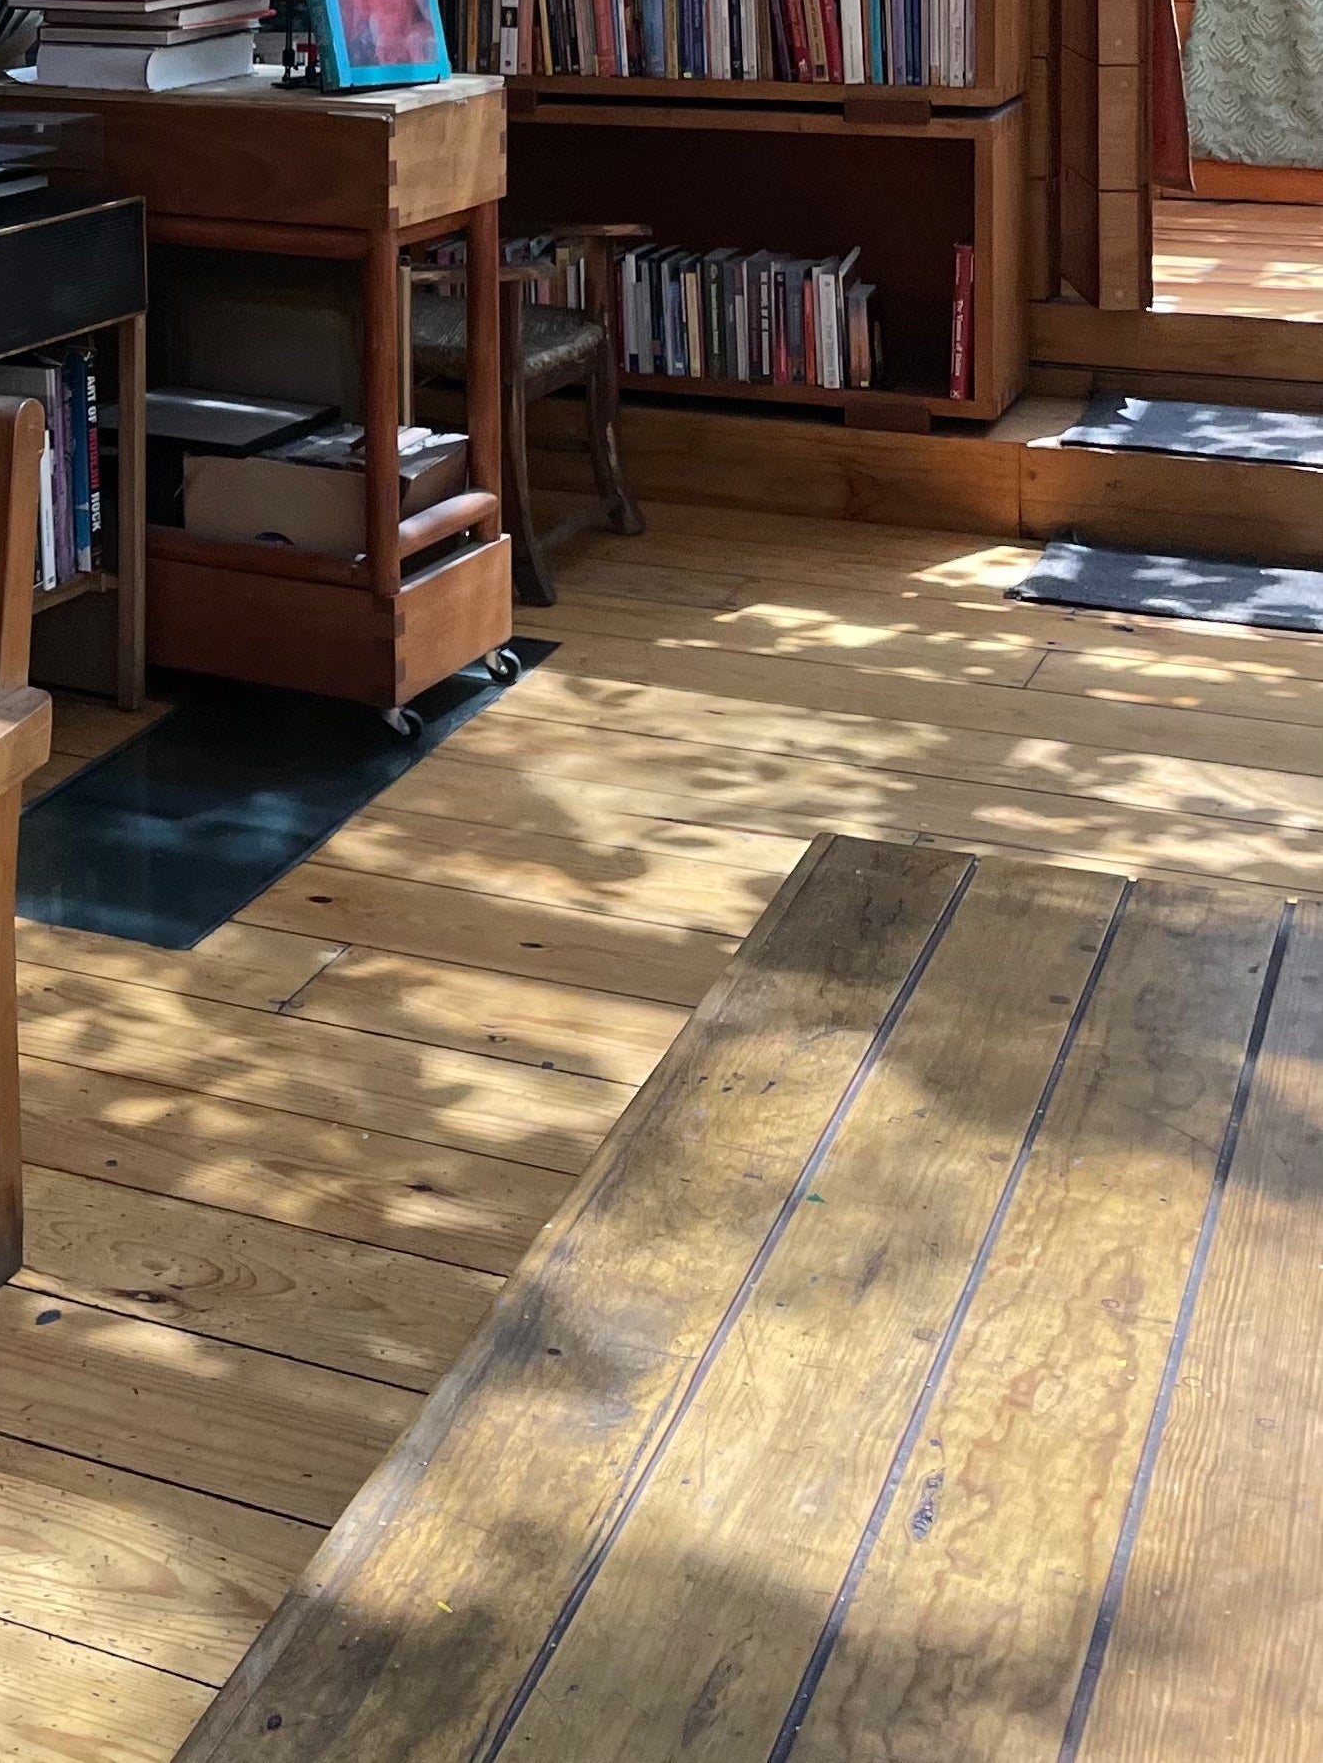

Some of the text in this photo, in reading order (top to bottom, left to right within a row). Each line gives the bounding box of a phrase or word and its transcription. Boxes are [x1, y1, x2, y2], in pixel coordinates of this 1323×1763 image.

[86, 375, 101, 532] ART OF MODERN ROCK
